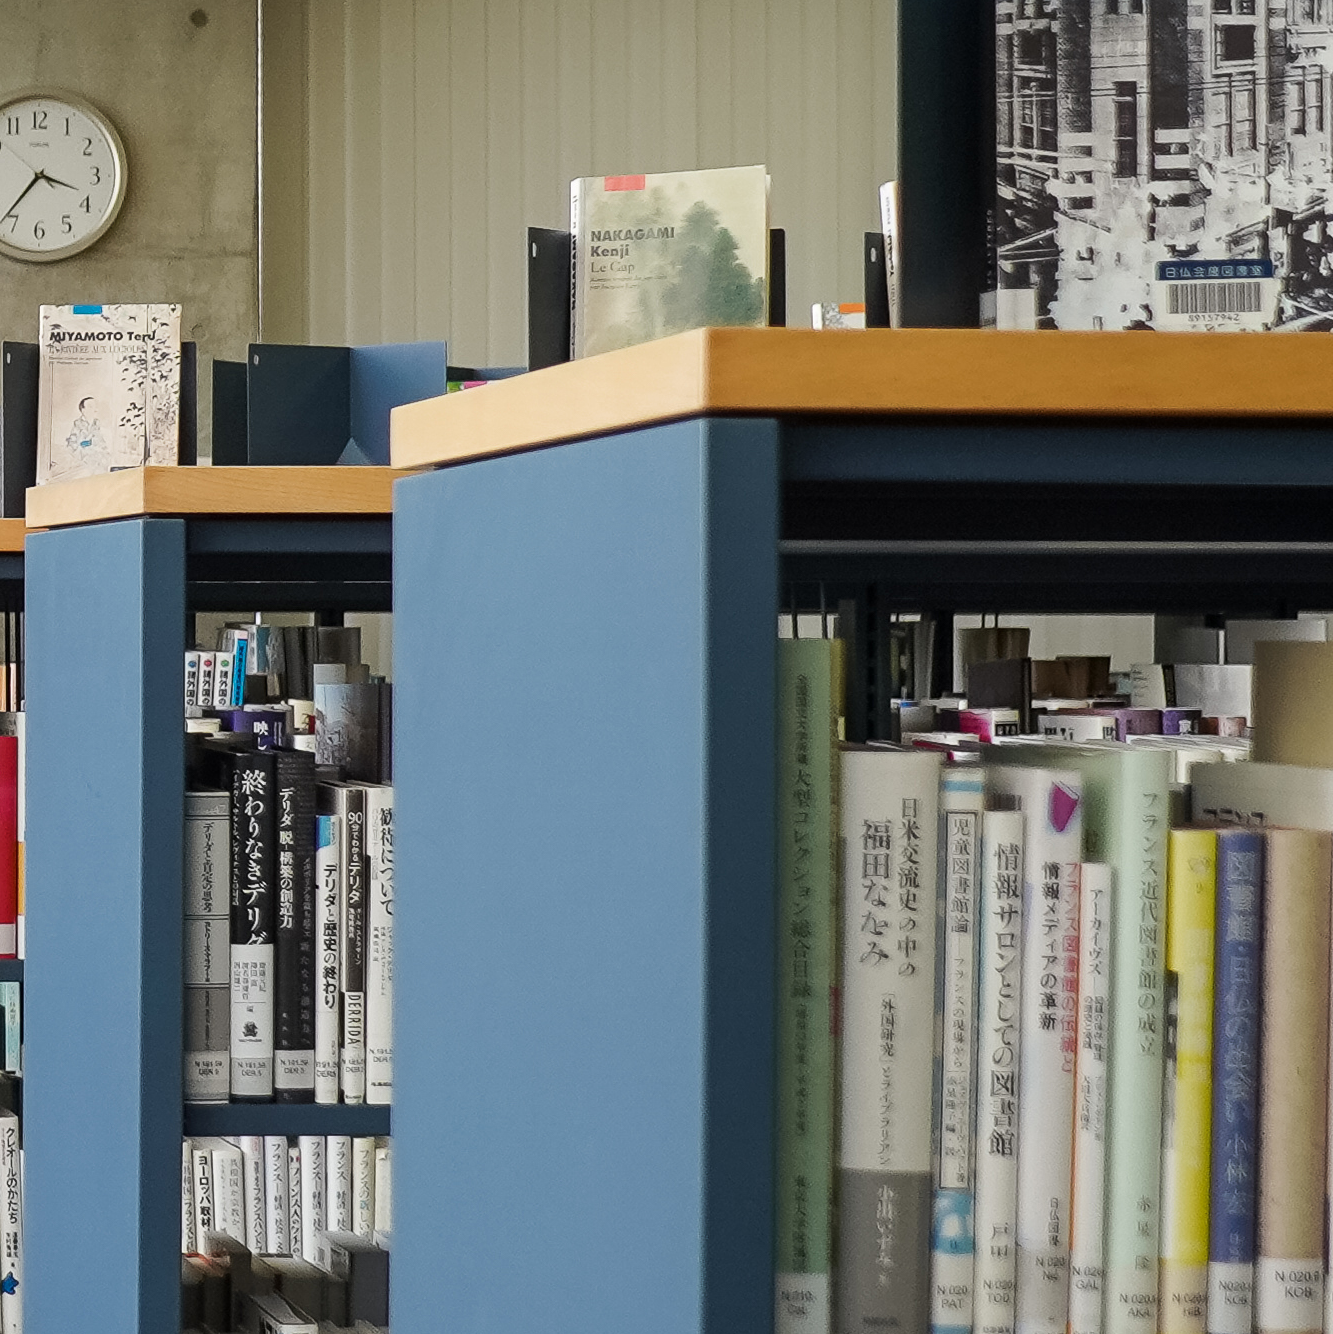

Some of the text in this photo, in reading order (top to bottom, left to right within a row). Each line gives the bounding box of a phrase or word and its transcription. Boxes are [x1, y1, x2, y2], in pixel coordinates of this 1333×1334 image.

[6, 117, 20, 135] 11
[31, 111, 48, 130] 12
[64, 117, 71, 136] 1
[83, 138, 92, 156] 2
[90, 166, 101, 186] 3
[79, 194, 91, 214] 4
[5, 214, 19, 234] 7
[34, 221, 46, 240] 6
[61, 215, 72, 234] 5
[591, 227, 675, 242] NAKAGAMI
[590, 244, 630, 259] Kenji
[591, 261, 607, 273] Le
[49, 331, 124, 342] MIYAMOTO
[279, 787, 293, 828] デリダ
[950, 817, 971, 935] 児童図書館論
[859, 819, 893, 966] 福田なをみ
[897, 797, 921, 978] 日米交流史の中の
[1136, 791, 1159, 1057] フランス近代図書館の成立
[323, 864, 337, 1010] デリダと歴史の終わり
[1037, 861, 1061, 1031] 情報メディアの革新
[988, 841, 1018, 1157] 情報サロンとしての図書館
[347, 994, 361, 1046] DERRIDA
[5, 1127, 18, 1224] クレオールのかたち
[983, 1279, 992, 1290] N
[1275, 1271, 1284, 1283] N
[937, 1284, 946, 1295] N
[988, 1294, 1011, 1303] TOD
[1284, 1286, 1313, 1298] KOB
[941, 1298, 964, 1309] PAT
